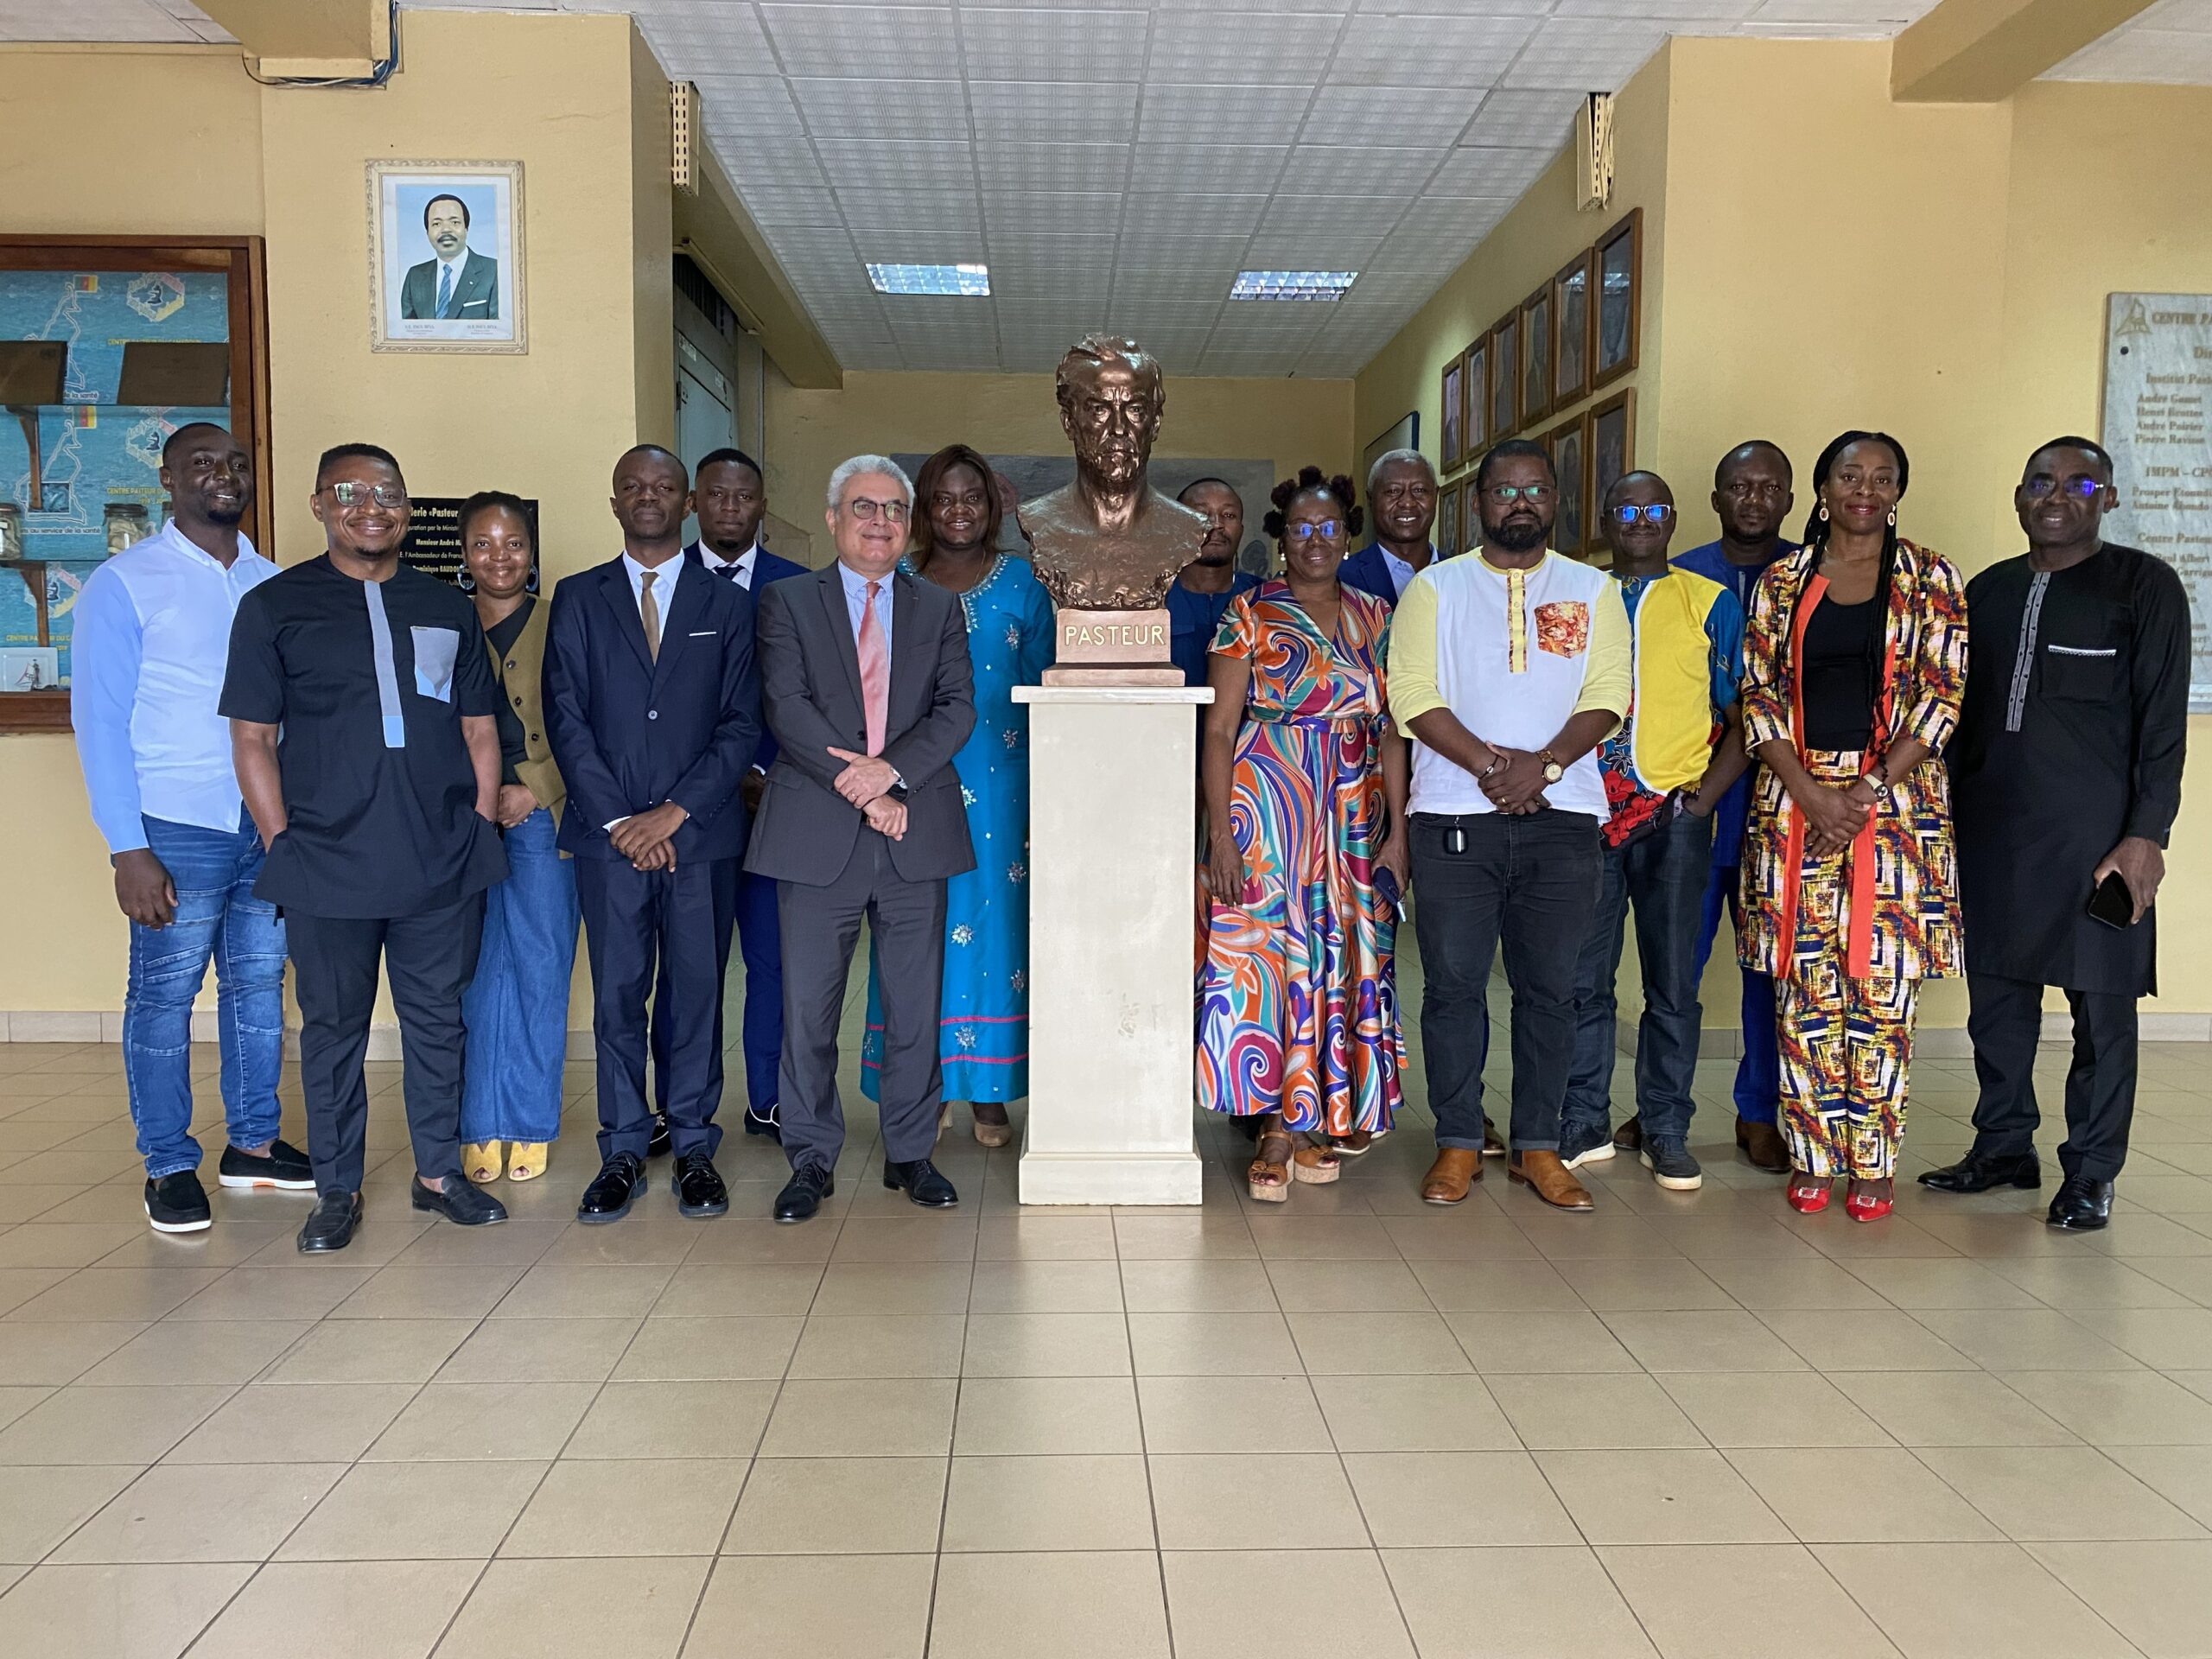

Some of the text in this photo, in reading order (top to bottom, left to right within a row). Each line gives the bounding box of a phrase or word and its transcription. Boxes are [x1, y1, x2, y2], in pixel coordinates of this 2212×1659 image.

[2152, 313, 2196, 325] CENTRE
[2146, 372, 2185, 384] Institut
[2137, 421, 2165, 430] André
[2135, 434, 2166, 443] Pierre
[65, 525, 73, 534] de
[83, 525, 100, 534] santé
[2138, 532, 2174, 543] Centre
[1065, 625, 1166, 645] PASTEUR
